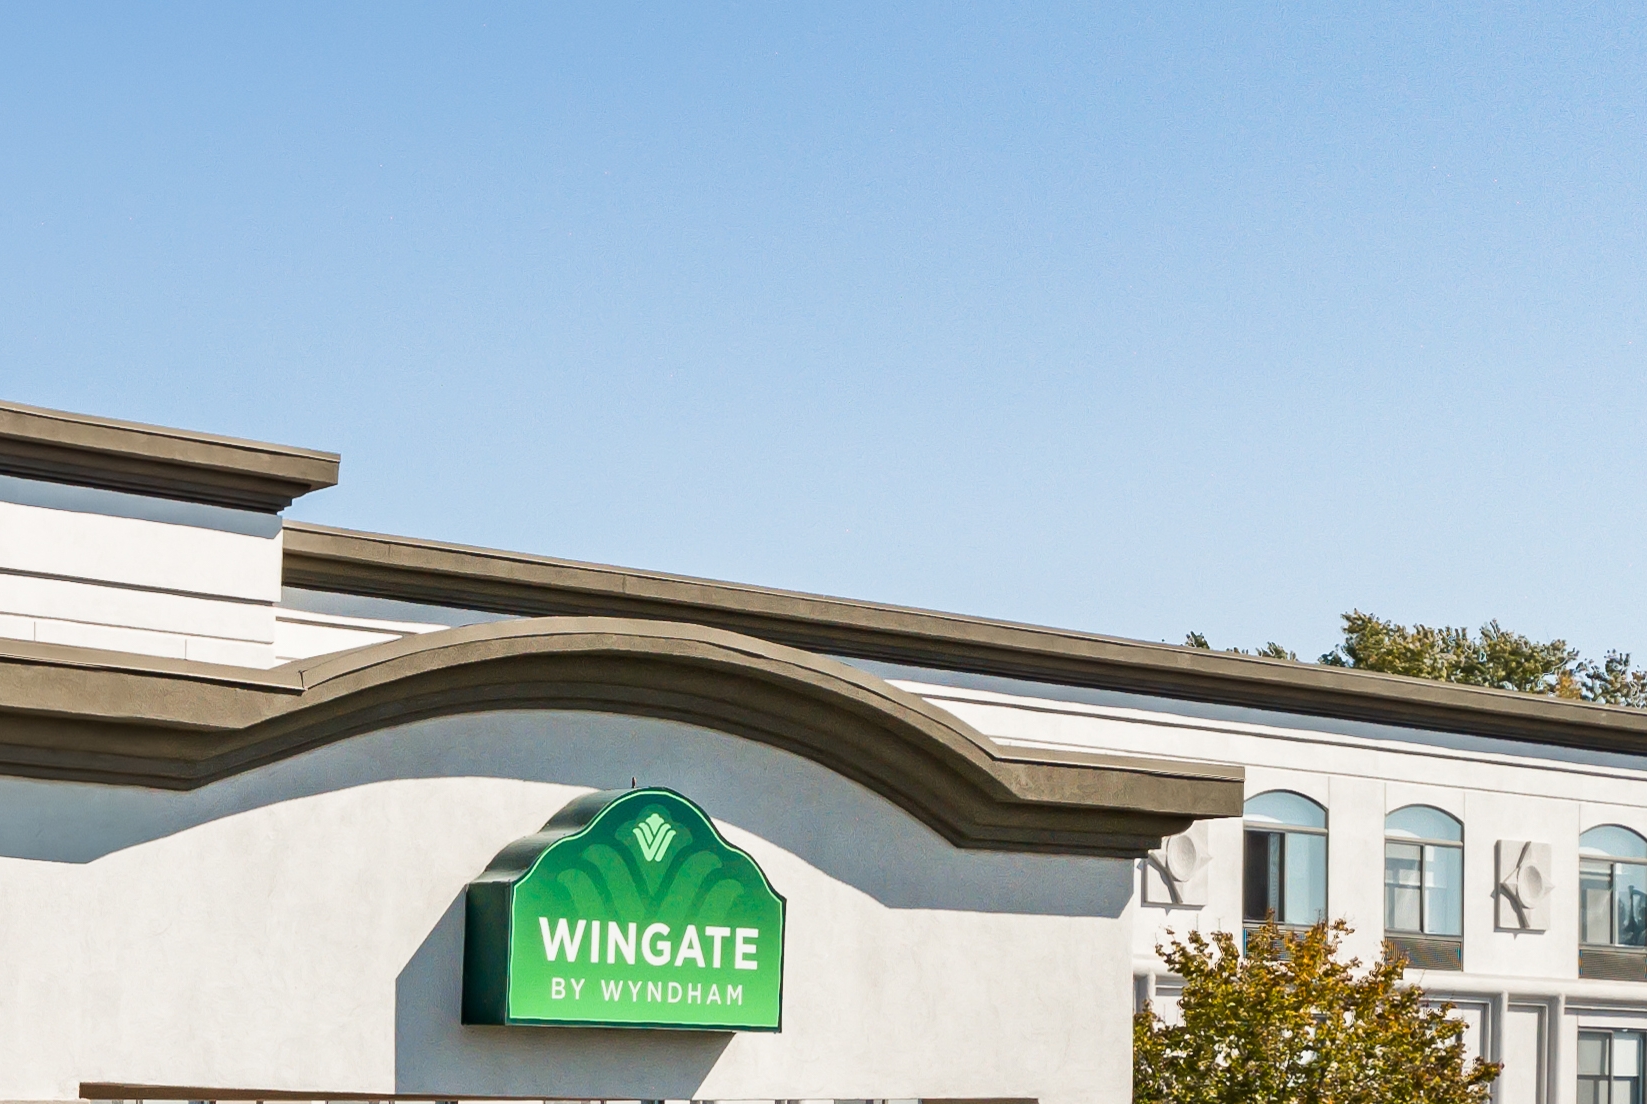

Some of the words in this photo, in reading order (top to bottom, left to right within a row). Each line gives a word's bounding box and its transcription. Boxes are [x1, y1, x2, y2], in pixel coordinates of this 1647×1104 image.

[538, 916, 760, 971] WINGATE
[550, 977, 586, 1001] BY
[600, 979, 744, 1006] WYNDHAM
